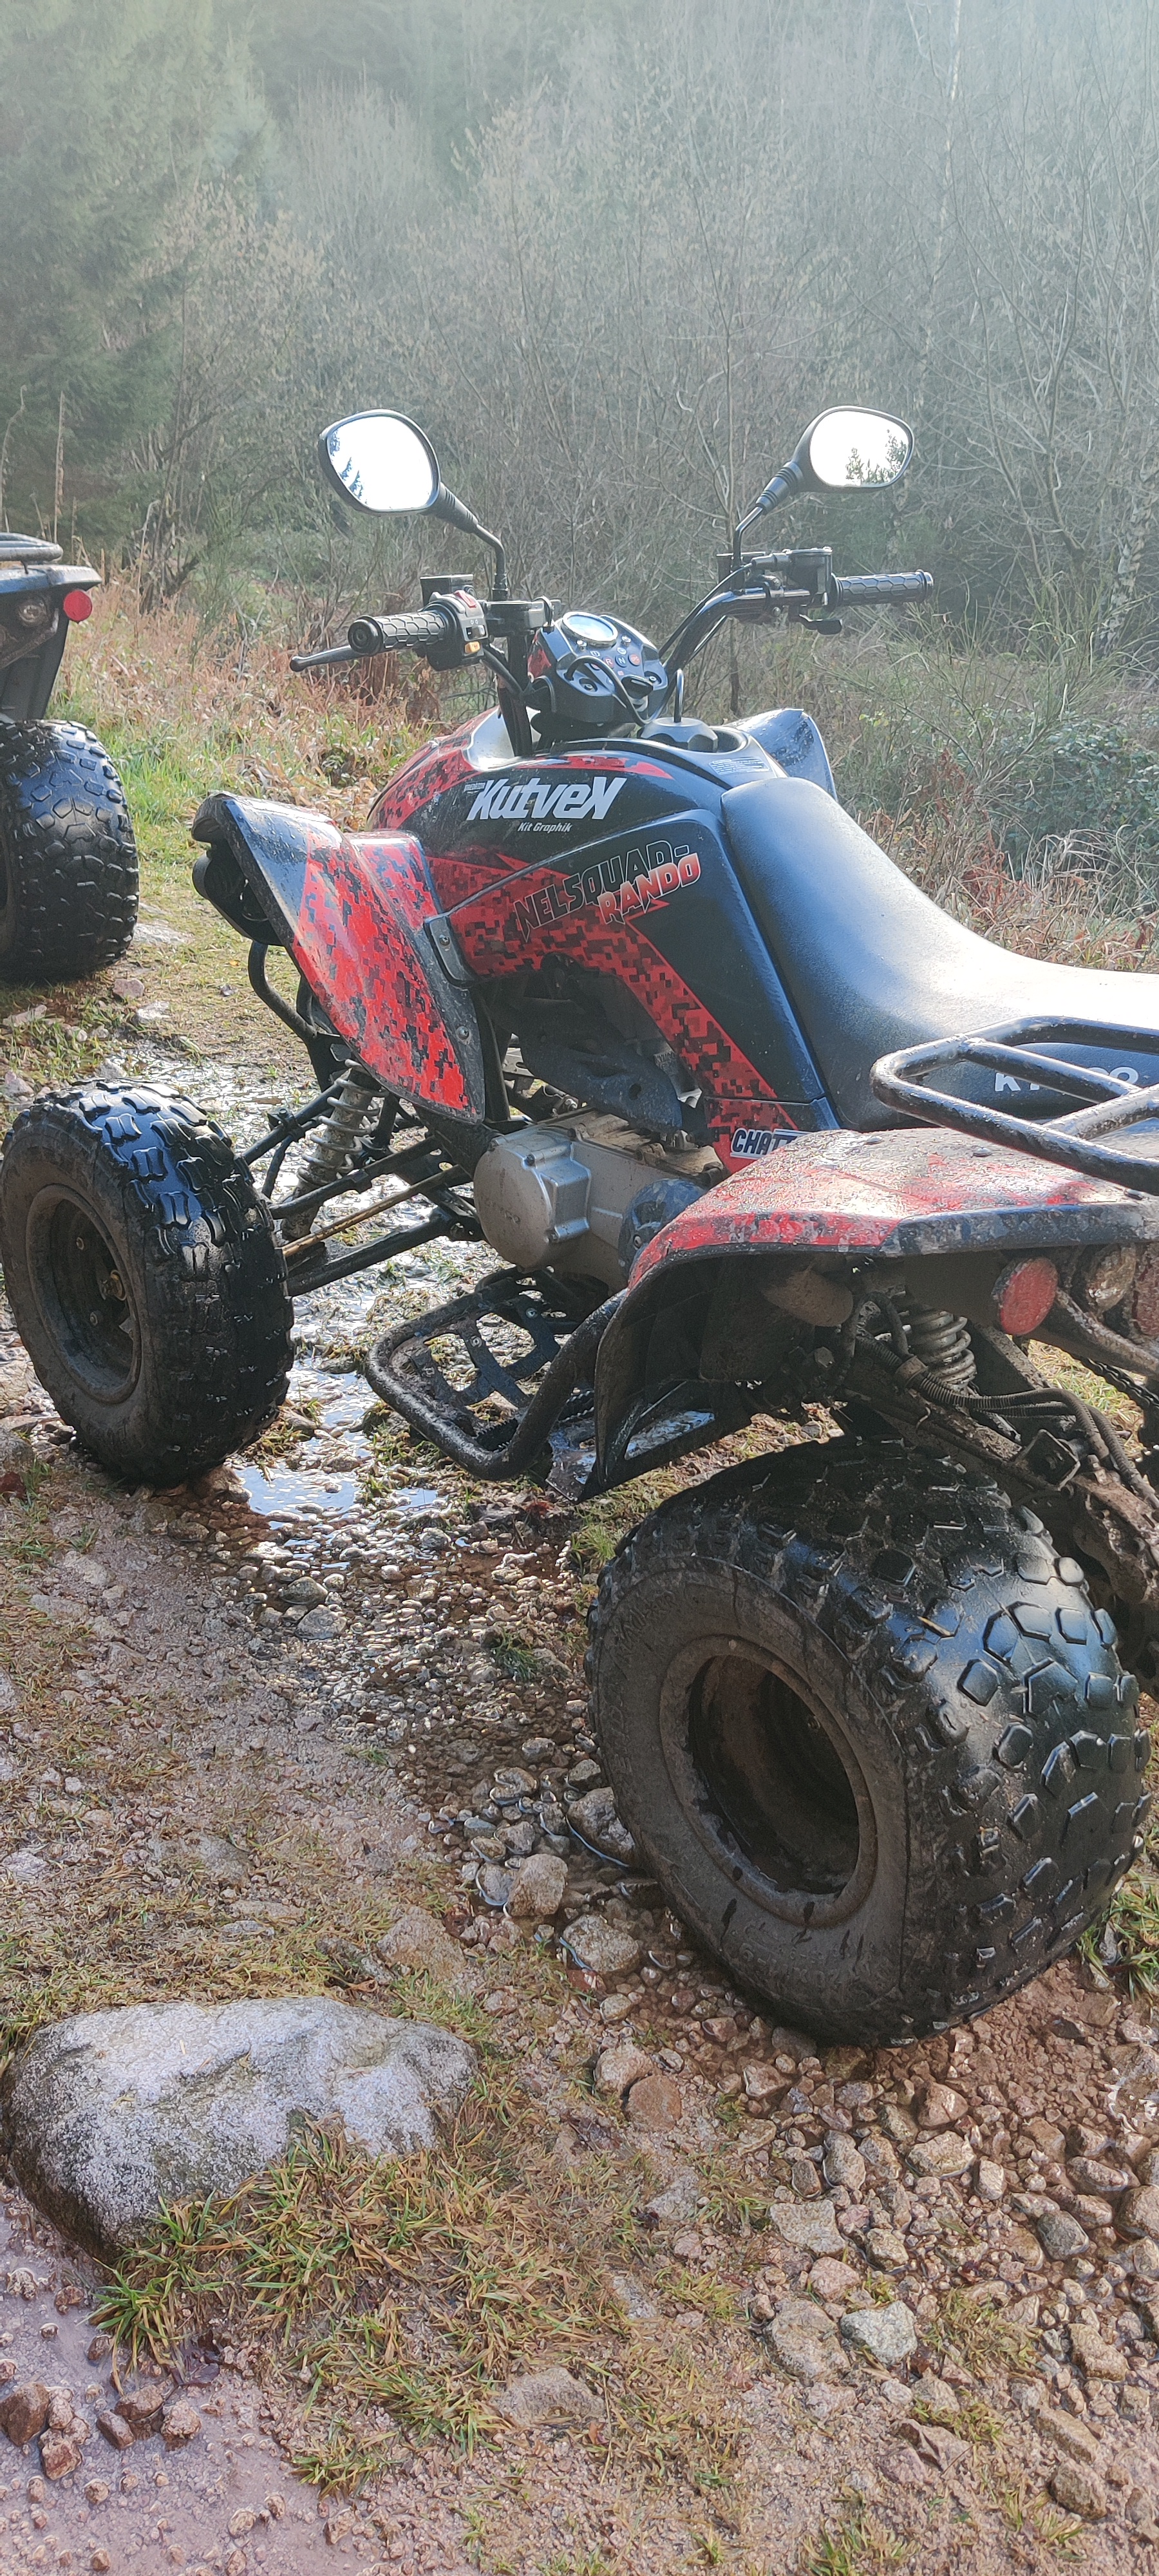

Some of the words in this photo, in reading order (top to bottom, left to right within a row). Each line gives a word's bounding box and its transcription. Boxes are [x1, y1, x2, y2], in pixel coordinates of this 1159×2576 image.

[517, 822, 533, 832] Kit
[532, 822, 573, 834] Graphik
[596, 852, 701, 925] RANDO
